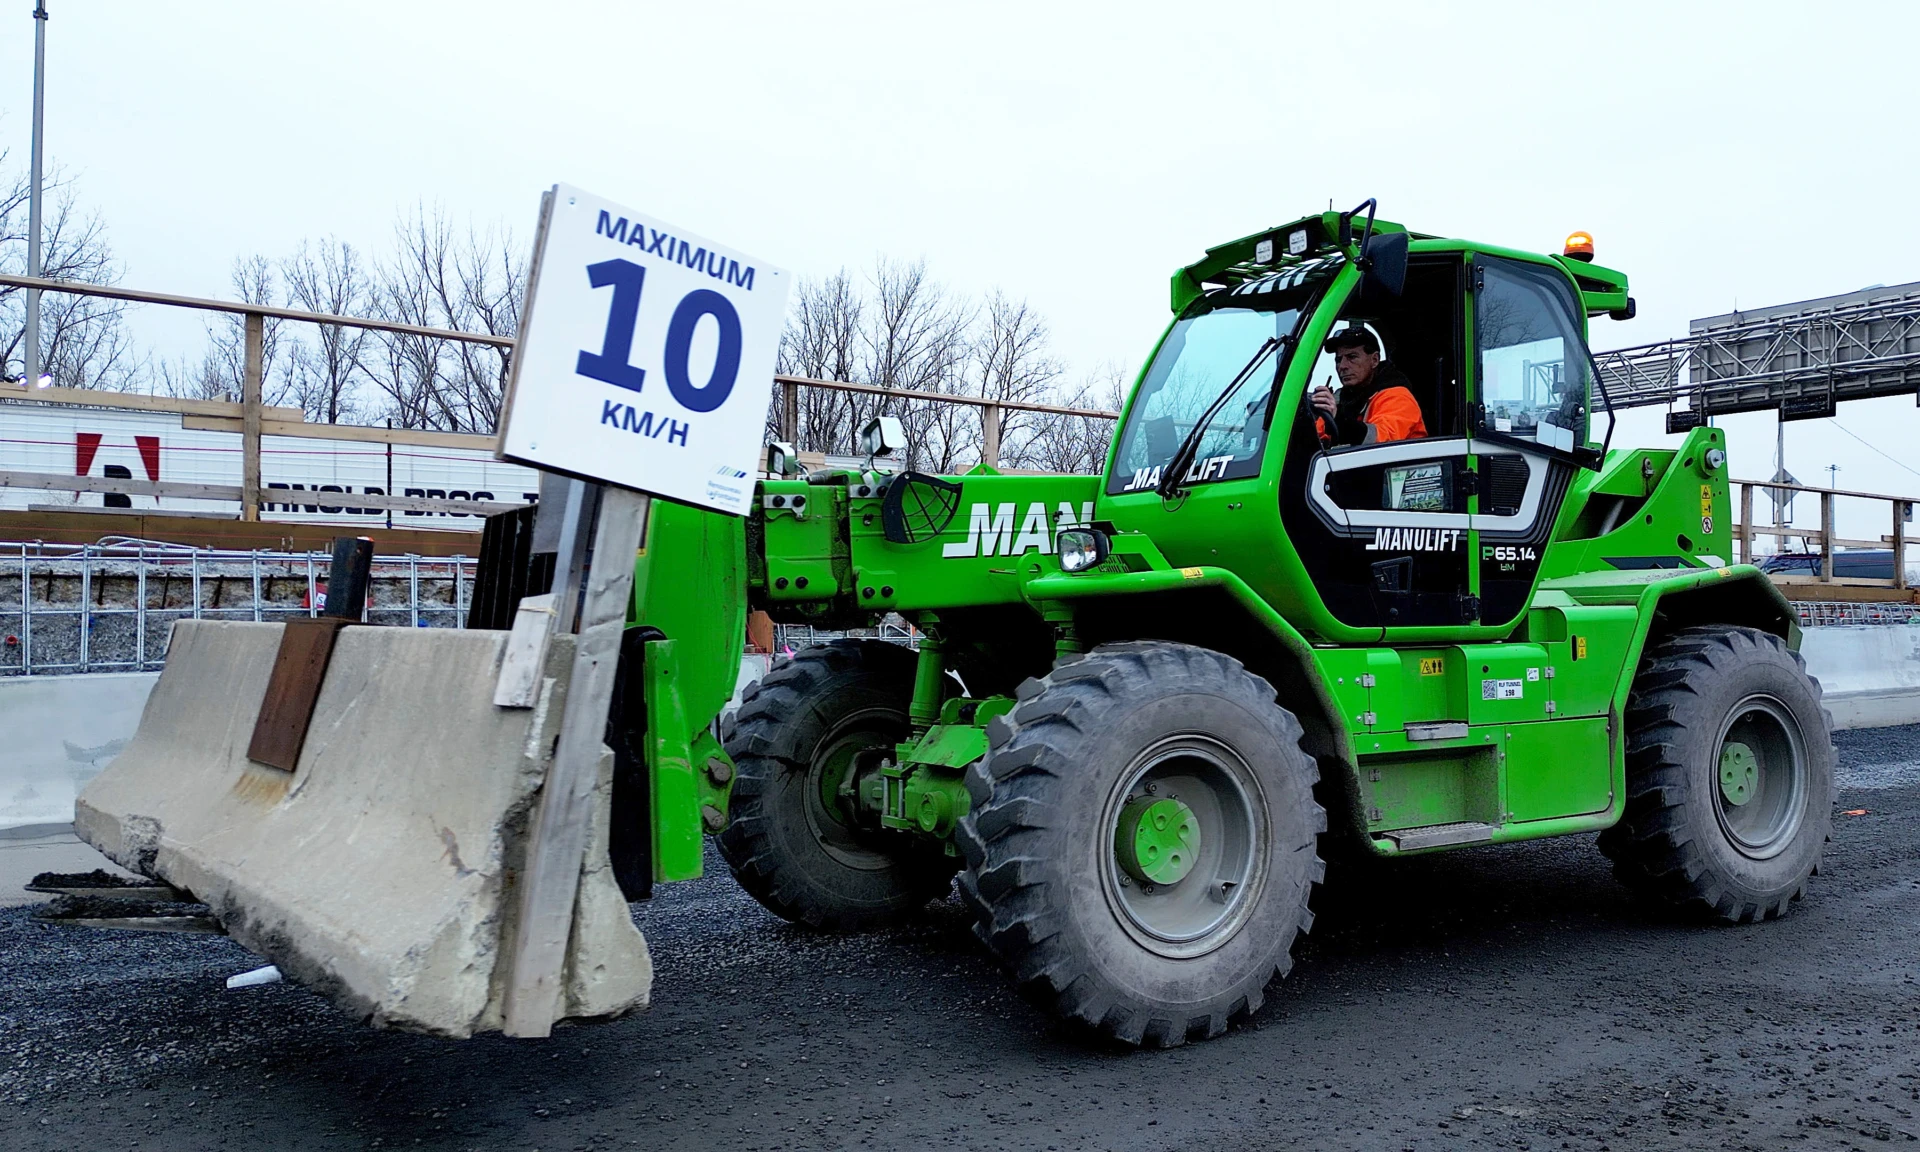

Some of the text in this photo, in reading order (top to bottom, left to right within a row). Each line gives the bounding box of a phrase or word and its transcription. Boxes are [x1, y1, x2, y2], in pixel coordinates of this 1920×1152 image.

[595, 208, 756, 291] MAXIMUM
[575, 258, 743, 413] 10
[600, 399, 690, 447] KM/H
[1123, 455, 1235, 491] MALIFT
[241, 482, 385, 516] RNOLD
[1365, 527, 1461, 552] MANULIFT
[1482, 546, 1537, 561] P65.14
